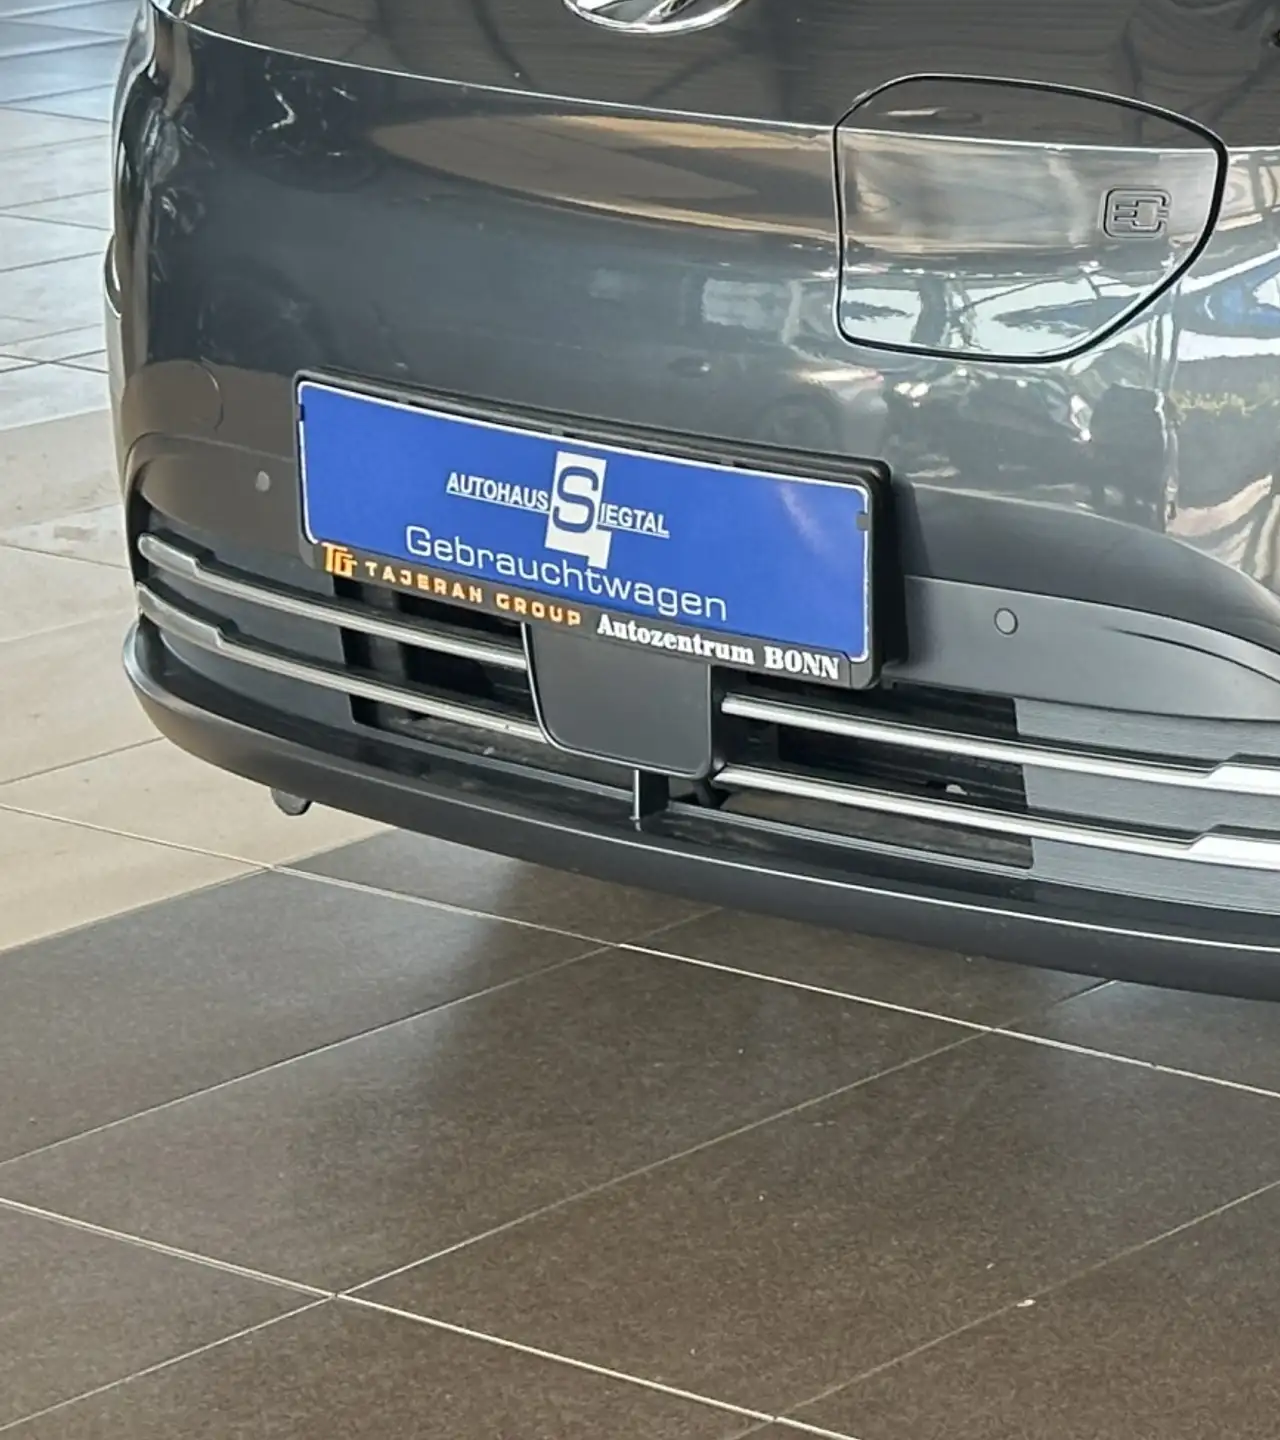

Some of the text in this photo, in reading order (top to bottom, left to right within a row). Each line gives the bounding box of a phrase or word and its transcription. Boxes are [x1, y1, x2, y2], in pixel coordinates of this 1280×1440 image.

[447, 471, 549, 512] AUTOHAUS
[364, 561, 484, 604] TAJERAN
[495, 592, 583, 627] GROUP
[596, 613, 756, 665] Autozentrum
[763, 645, 841, 681] BONN
[405, 525, 728, 622] Gebrauchtwagen
